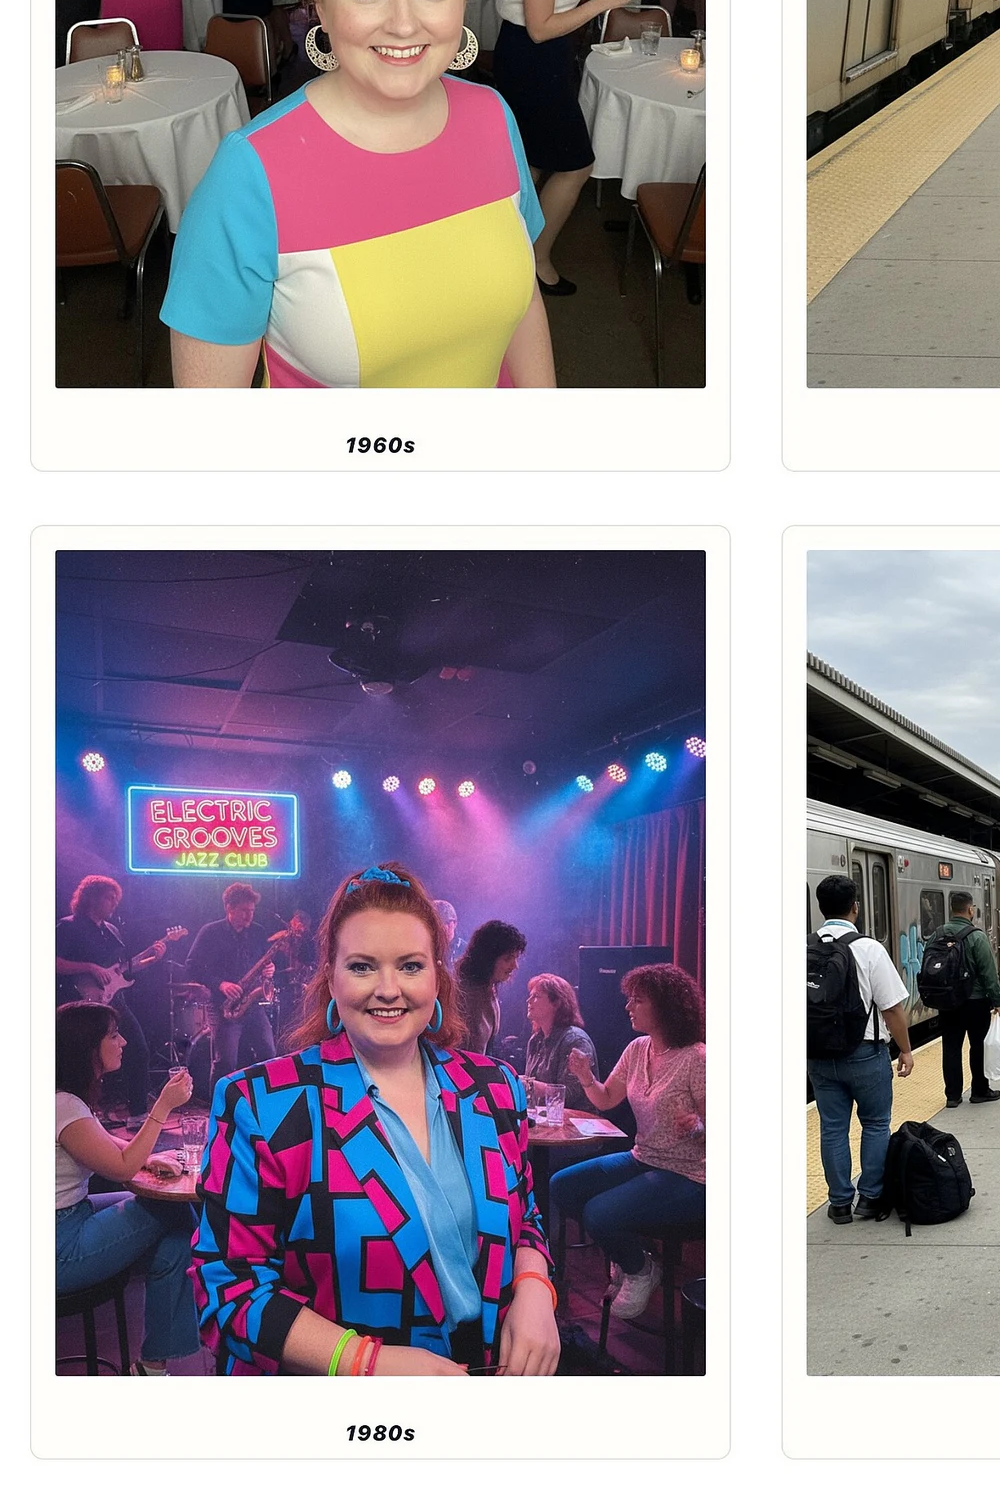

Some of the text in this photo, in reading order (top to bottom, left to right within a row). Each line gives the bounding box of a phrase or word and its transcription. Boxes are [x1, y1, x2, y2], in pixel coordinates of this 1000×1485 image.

[150, 800, 273, 823] ELECTRIC
[153, 826, 278, 849] GROOVES
[175, 852, 268, 867] JAZZ CLUB
